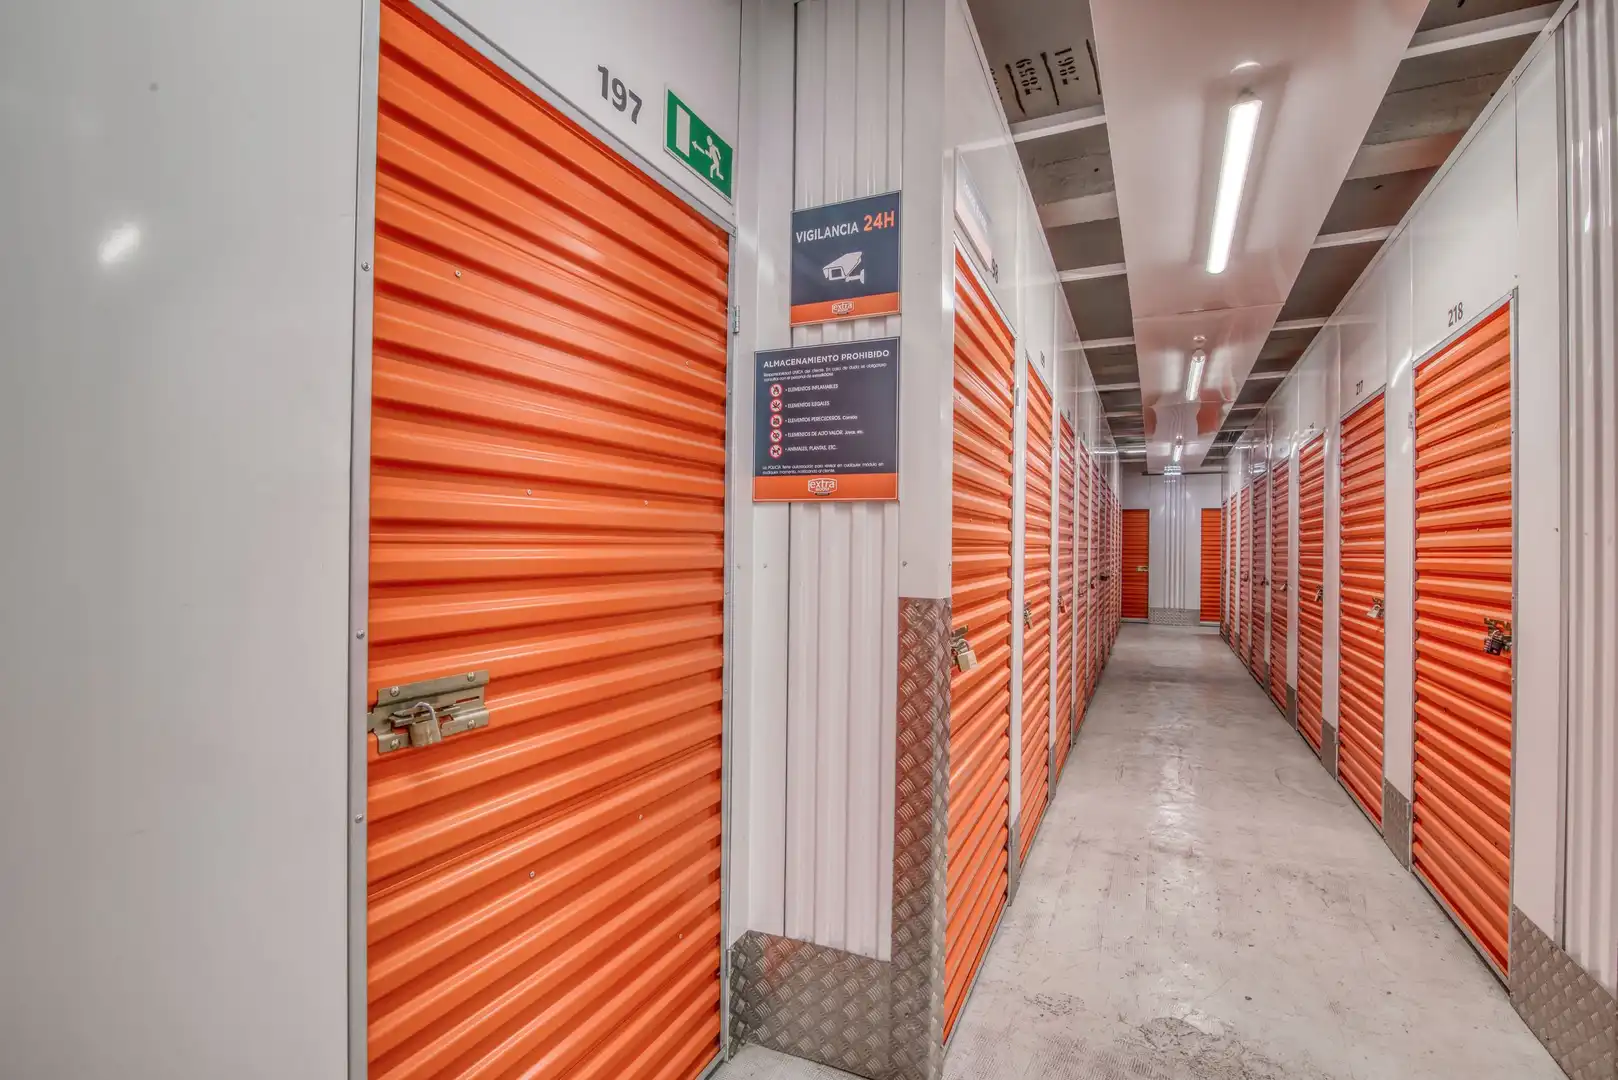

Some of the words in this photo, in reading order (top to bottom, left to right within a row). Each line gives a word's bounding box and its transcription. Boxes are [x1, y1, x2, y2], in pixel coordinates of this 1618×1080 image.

[597, 64, 642, 125] 197
[795, 221, 859, 243] VIGILANCIA
[863, 210, 895, 232] 24H
[1448, 302, 1464, 328] 218
[763, 354, 839, 368] ALMACENAMIENTO
[841, 349, 890, 361] PROHIBIDO
[810, 480, 835, 490] extra
